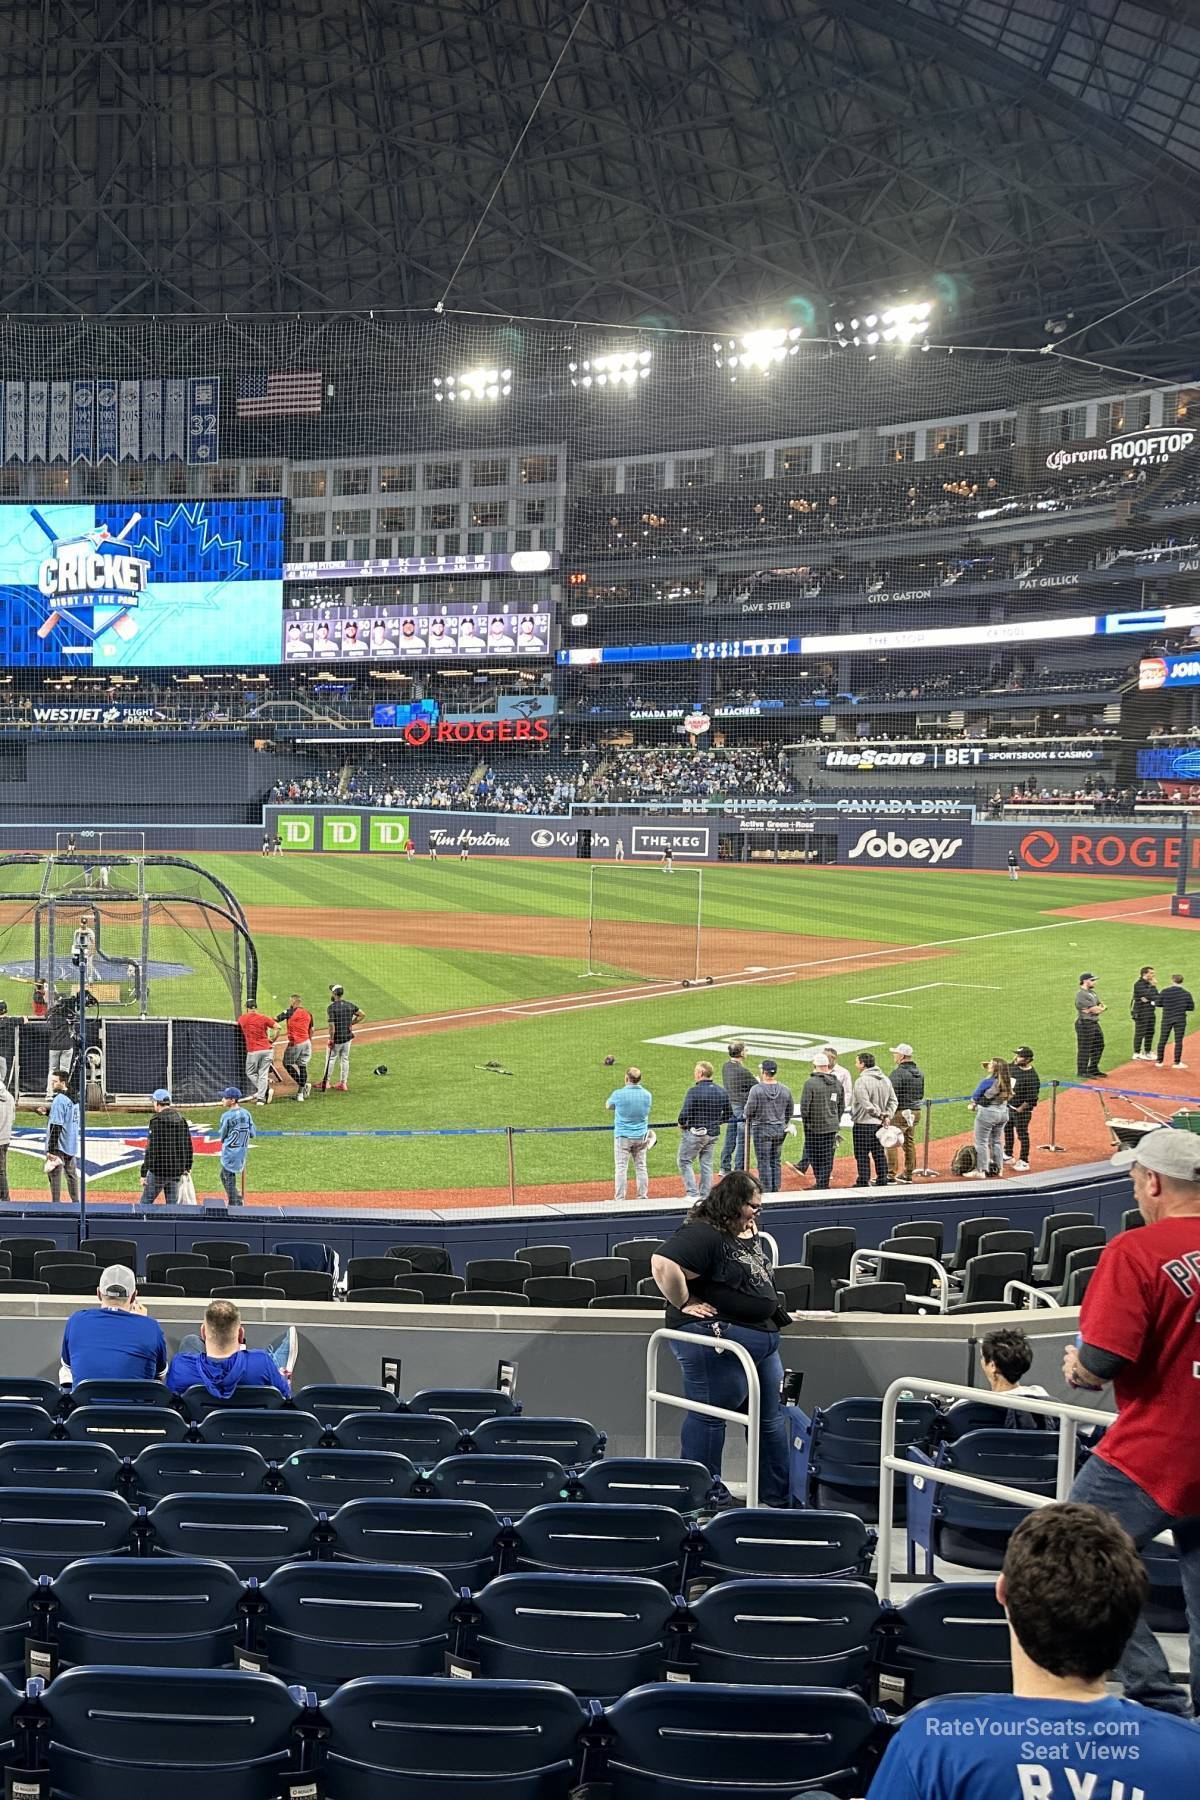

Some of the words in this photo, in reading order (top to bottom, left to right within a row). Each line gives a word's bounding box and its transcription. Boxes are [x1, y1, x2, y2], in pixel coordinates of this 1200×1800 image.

[191, 415, 217, 435] 32
[1046, 449, 1107, 470] Corona
[1110, 433, 1193, 460] ROOFTOP
[1133, 454, 1169, 466] PATIO
[38, 554, 150, 596] CRICKET
[1019, 580, 1038, 590] PAT
[1040, 575, 1079, 588] GILLICK
[51, 595, 79, 607] NIGHT
[83, 595, 93, 604] AT
[98, 594, 115, 604] THE
[868, 593, 889, 603] CITO
[893, 590, 931, 601] GASTON
[742, 603, 764, 612] DAVE
[767, 602, 791, 611] STIEB
[303, 622, 314, 632] 27
[418, 618, 428, 628] 13
[477, 617, 487, 627] 12
[33, 709, 102, 722] WESTJET
[123, 709, 154, 717] FLIGHT
[630, 710, 665, 718] CANADA
[667, 710, 684, 718] DRY
[715, 708, 760, 716] BLEACHERS
[437, 719, 549, 742] ROGERS
[826, 750, 926, 766] theScore
[945, 749, 983, 765] BET
[988, 751, 1047, 761] SPORTSBOOK
[1057, 750, 1093, 760] CASINO
[837, 800, 919, 814] CANADA
[81, 830, 94, 838] 400
[282, 821, 310, 843] TD
[328, 822, 357, 844] TD
[375, 822, 404, 844] TD
[429, 829, 457, 846] Tim
[455, 828, 510, 848] Hortons
[557, 831, 610, 847] Kuota
[641, 836, 668, 847] THE
[676, 837, 700, 847] KEG
[849, 829, 962, 863] Sobeys
[230, 1127, 249, 1149] 27
